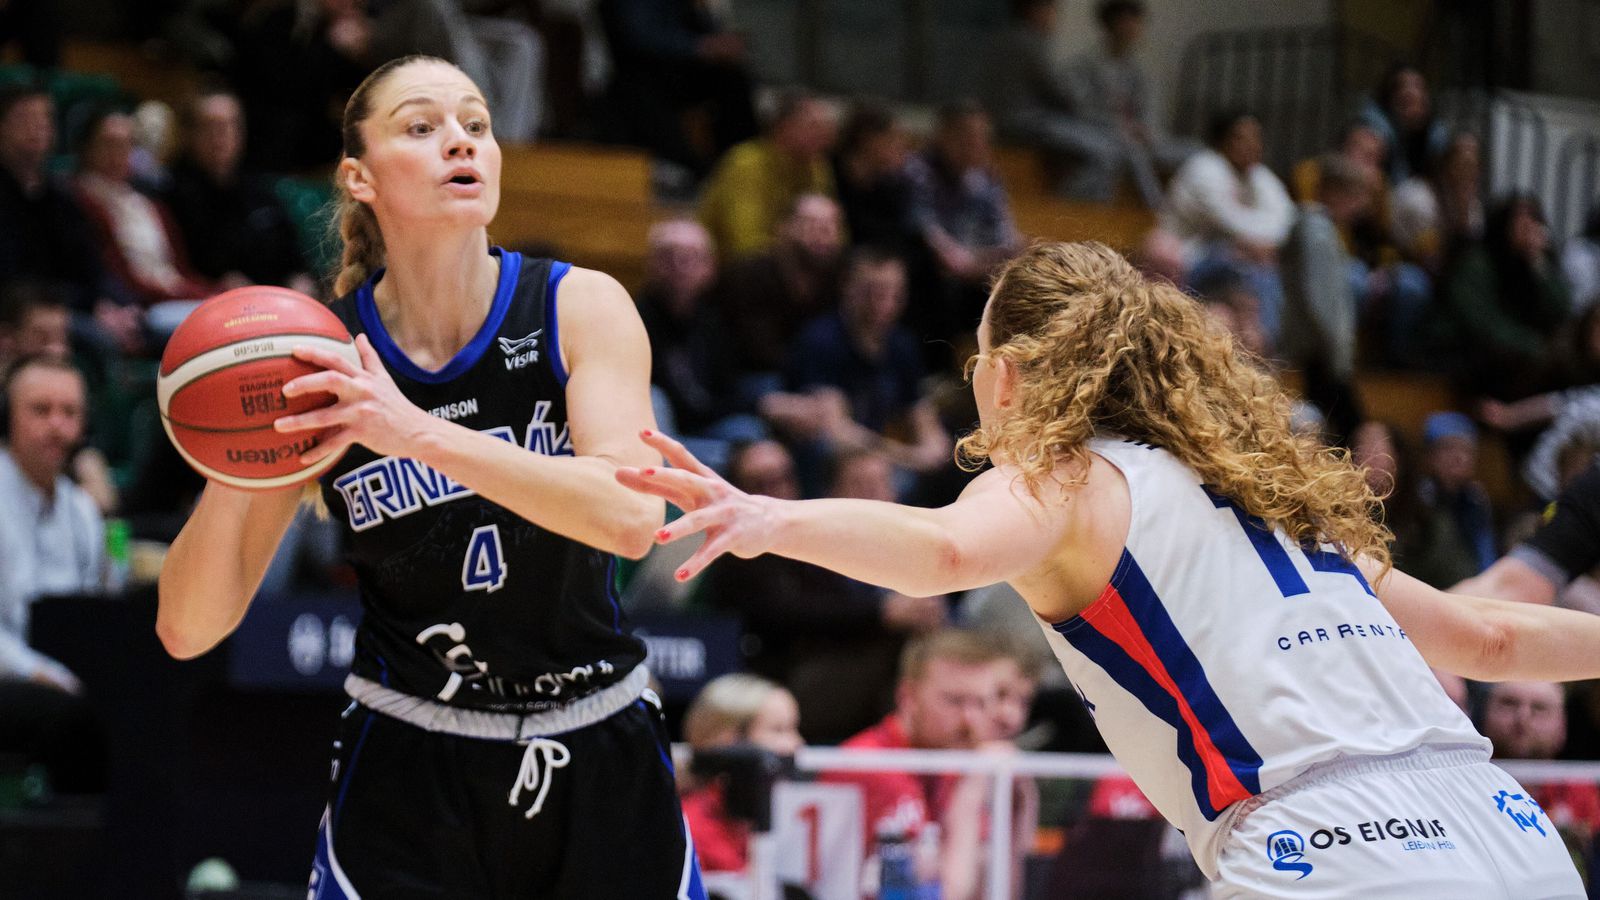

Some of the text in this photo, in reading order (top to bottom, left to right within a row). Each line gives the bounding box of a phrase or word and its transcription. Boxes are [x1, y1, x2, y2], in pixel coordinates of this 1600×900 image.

[239, 391, 289, 417] FIBA
[428, 397, 479, 421] ENSON
[226, 435, 321, 465] molten
[461, 524, 508, 593] 4
[1277, 628, 1330, 651] CAR
[1309, 826, 1352, 850] OS
